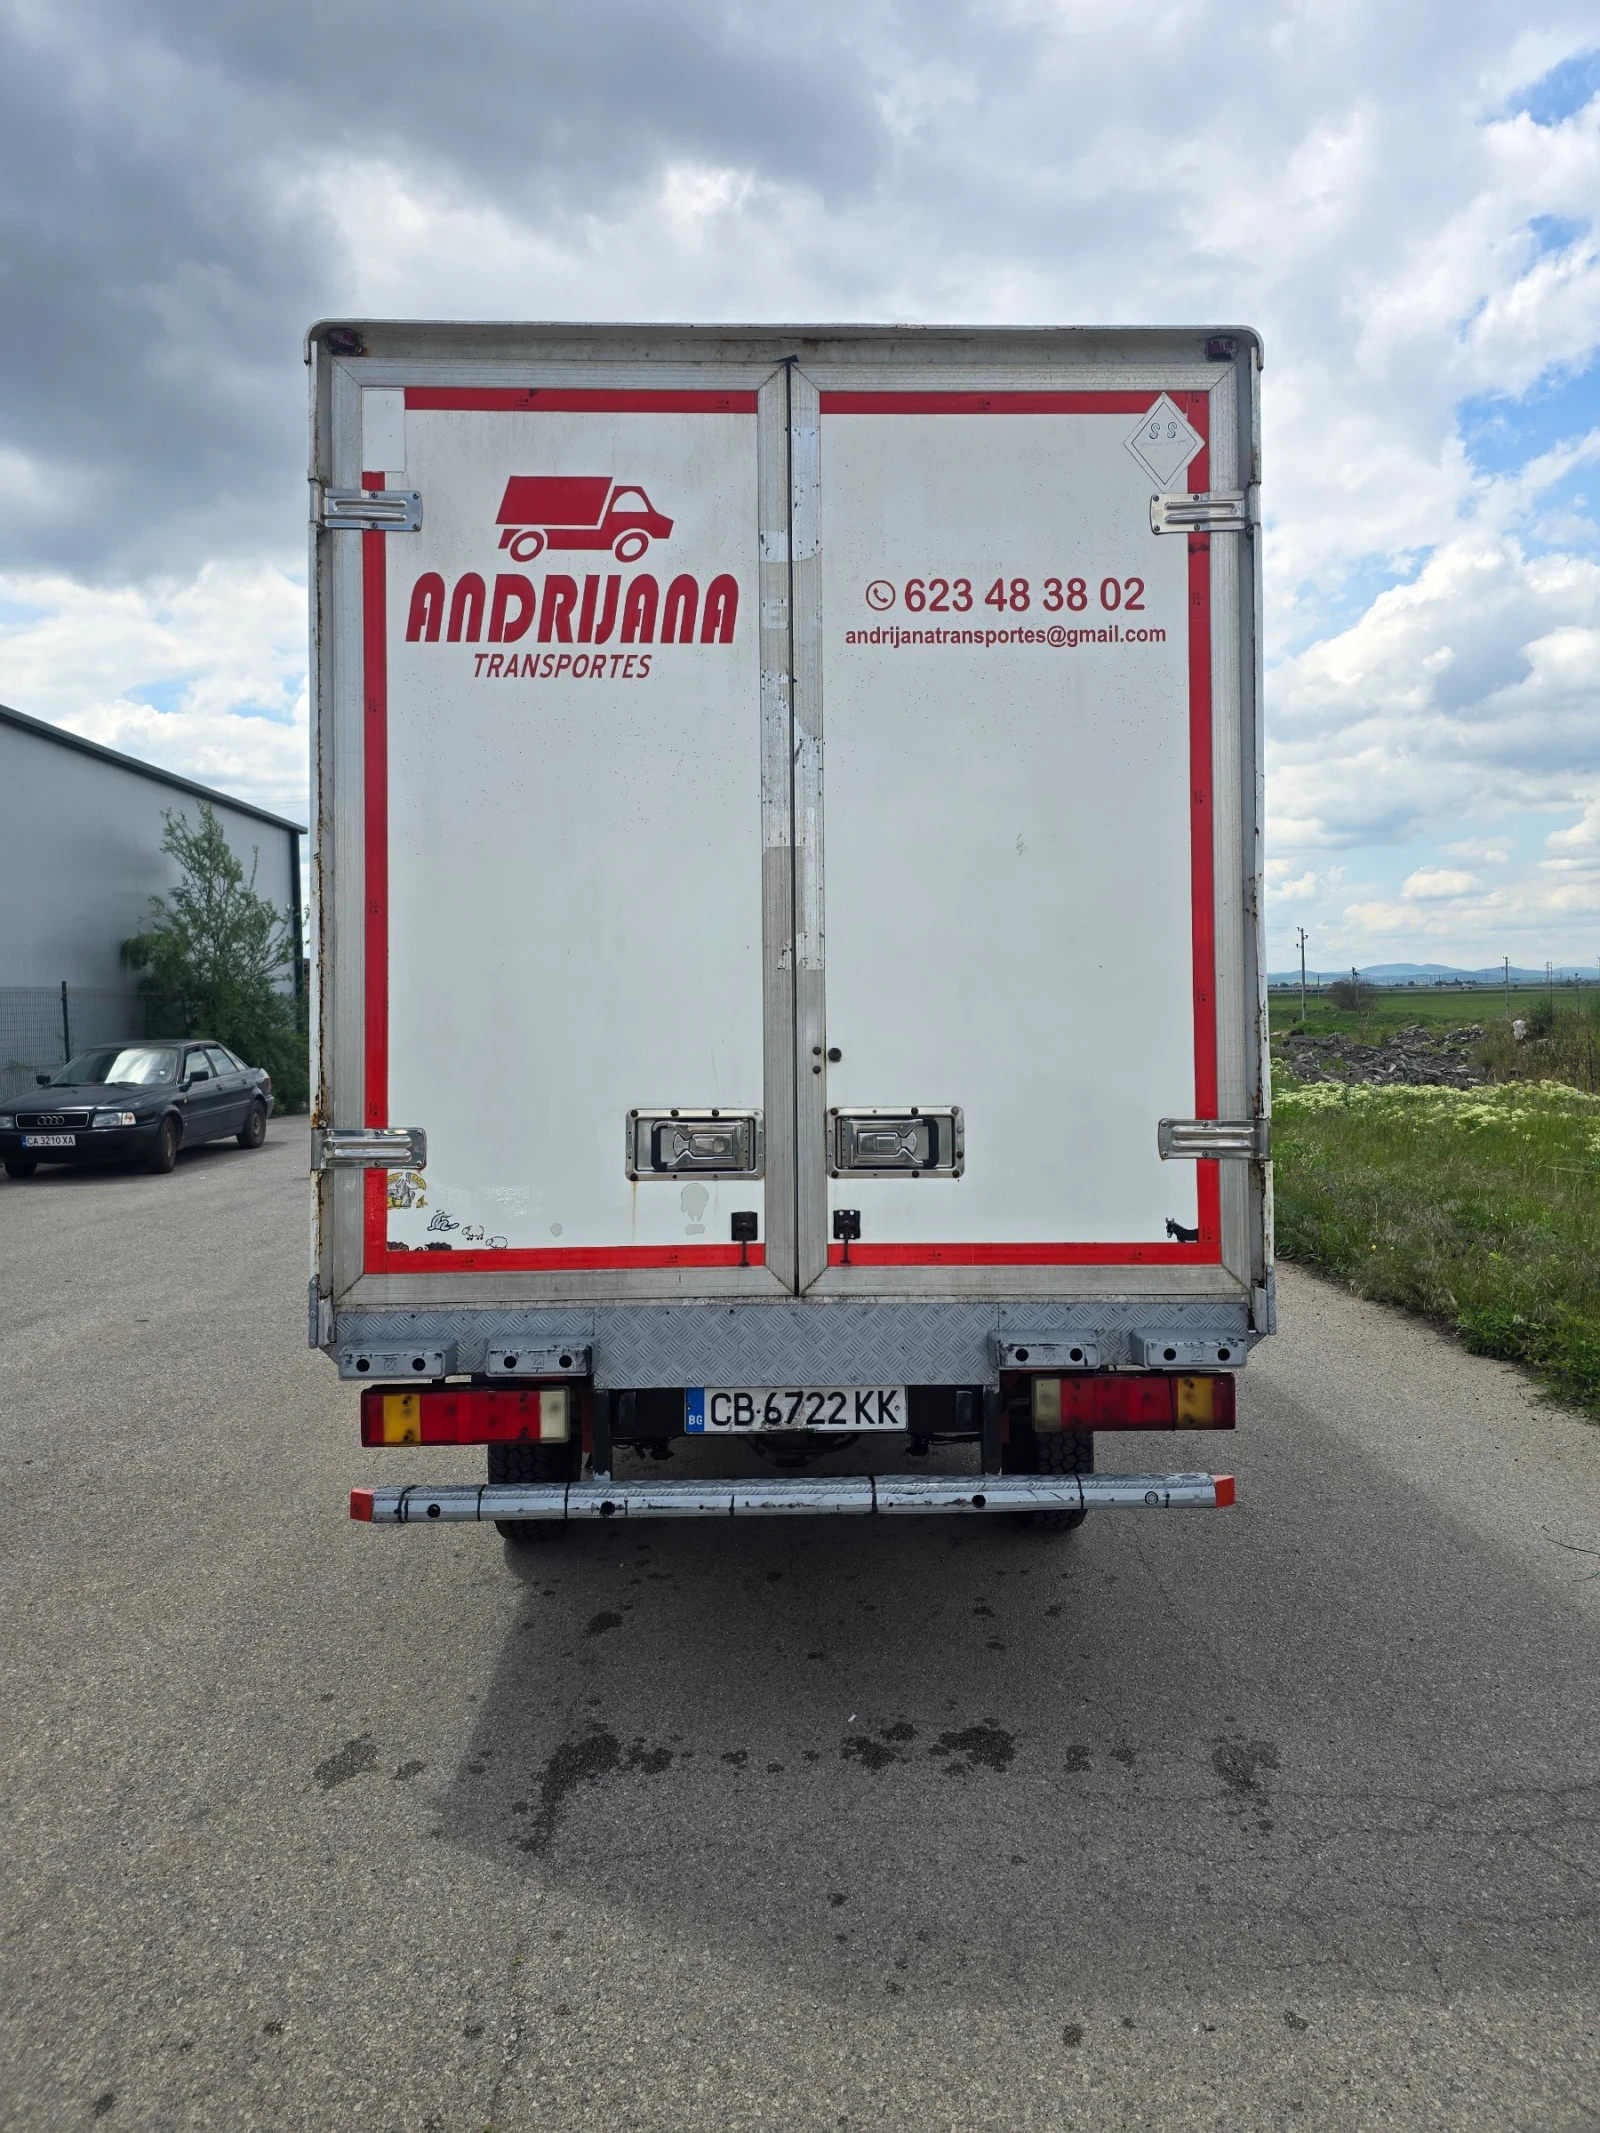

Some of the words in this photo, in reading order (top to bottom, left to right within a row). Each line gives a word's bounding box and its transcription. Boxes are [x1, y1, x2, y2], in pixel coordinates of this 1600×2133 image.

[905, 579, 973, 612] 623
[984, 578, 1030, 612] 48
[1043, 578, 1088, 611] 38
[1100, 578, 1146, 610] 02
[405, 571, 739, 645] ANDRIJANA
[845, 626, 1166, 648] andrijanatransportes@gmail.com
[474, 654, 652, 678] TRANSPORTES
[27, 1137, 38, 1145] CA
[40, 1137, 60, 1145] 3210
[62, 1136, 74, 1144] XA
[688, 1415, 703, 1425] BG
[711, 1393, 754, 1426] CB
[764, 1392, 847, 1425] 6722
[855, 1391, 898, 1424] KK
